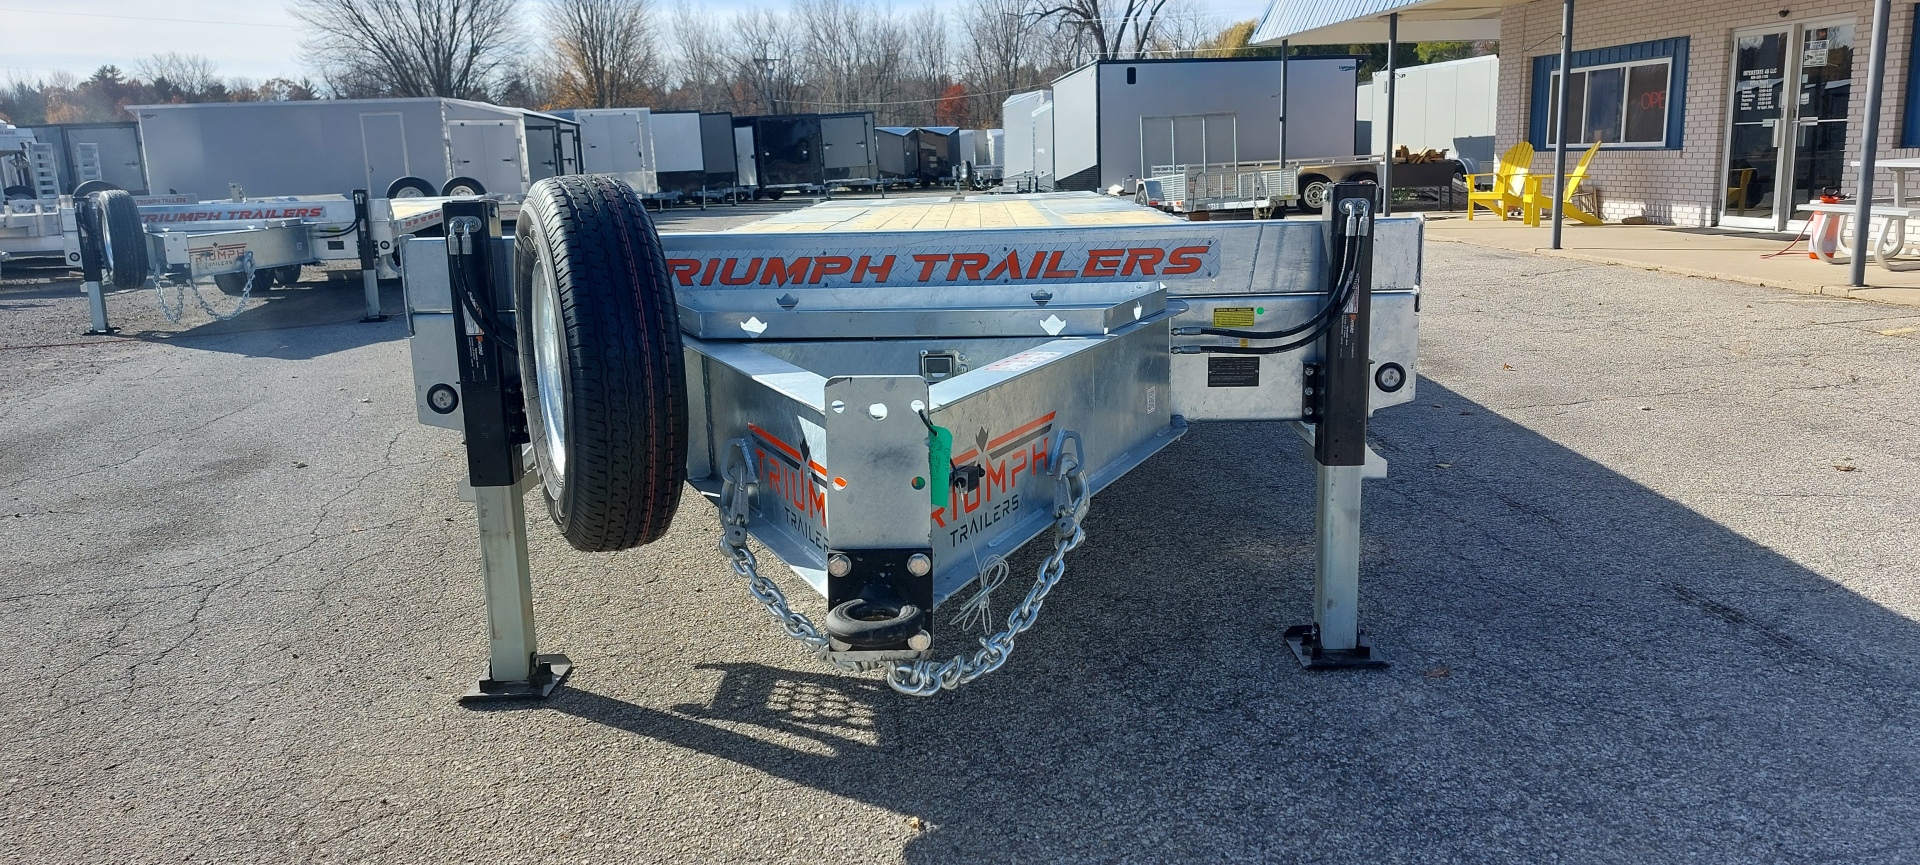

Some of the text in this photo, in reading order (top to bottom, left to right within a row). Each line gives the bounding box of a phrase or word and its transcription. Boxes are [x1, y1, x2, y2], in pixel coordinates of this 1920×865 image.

[1641, 90, 1666, 109] OPE
[227, 206, 324, 220] TRAILERS
[667, 246, 1210, 288] RIUMPH TRAILERS
[755, 448, 827, 528] TRIUM
[784, 506, 829, 553] TRAILER
[949, 494, 1019, 548] TRAILERS
